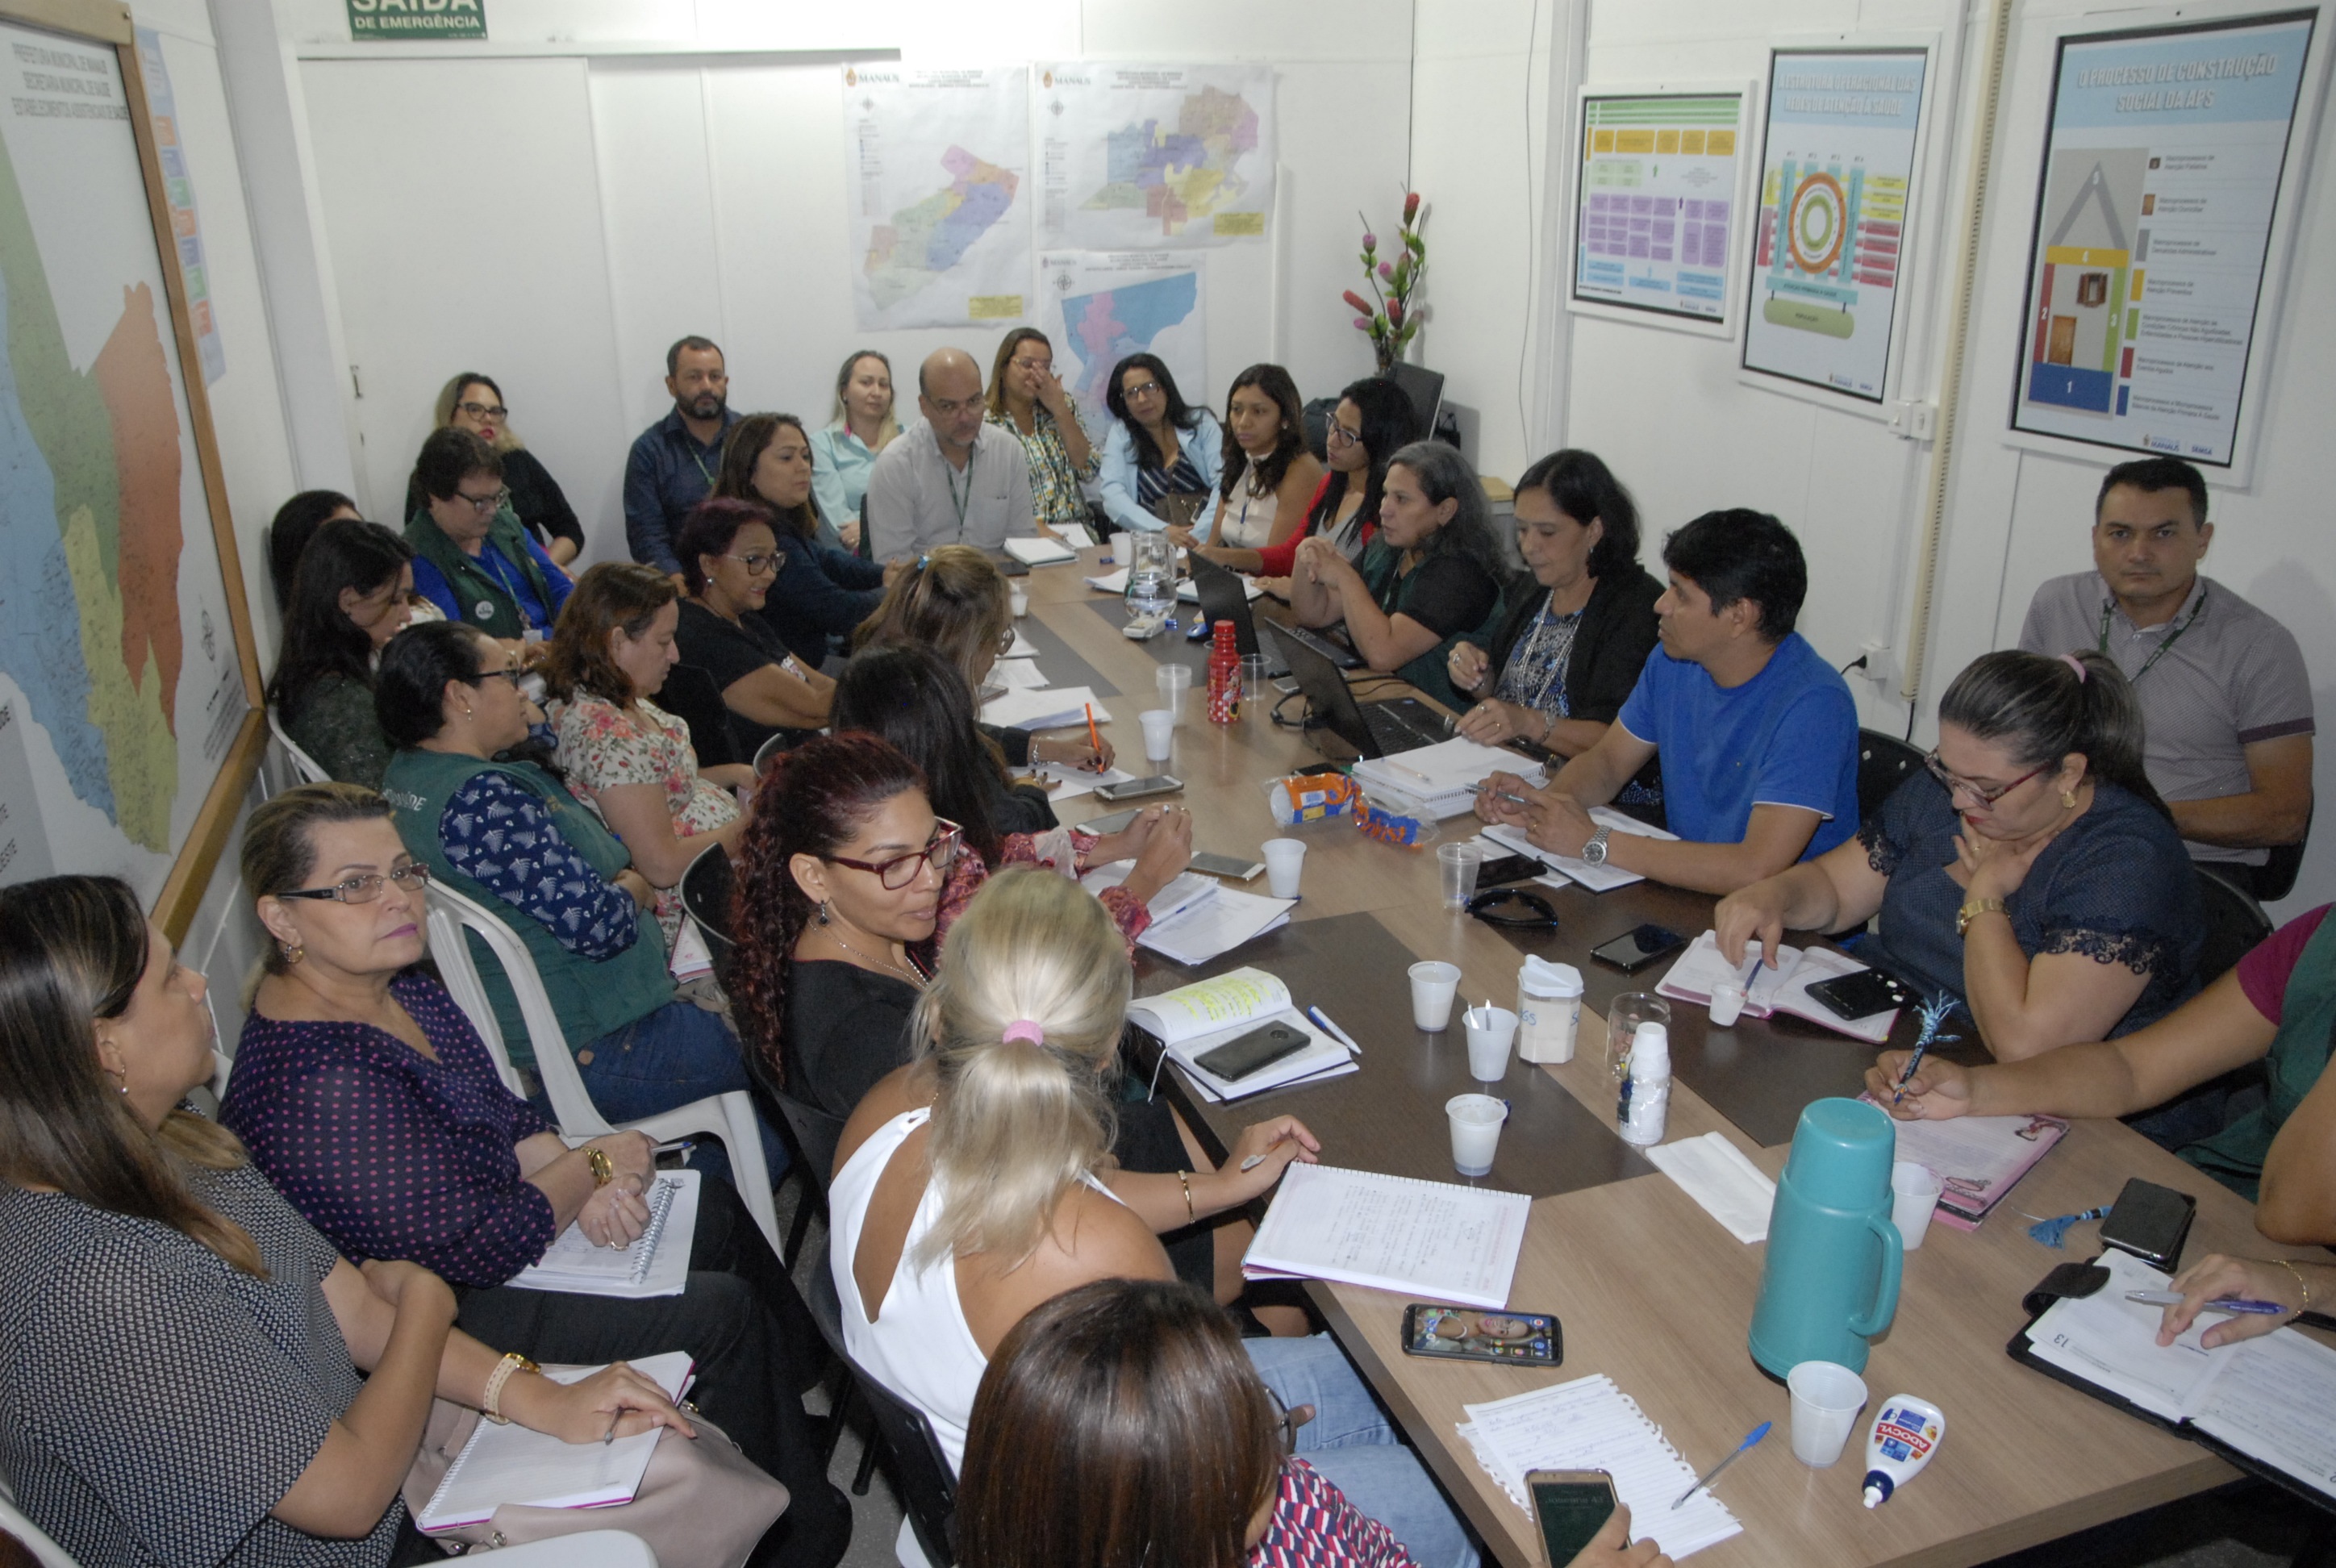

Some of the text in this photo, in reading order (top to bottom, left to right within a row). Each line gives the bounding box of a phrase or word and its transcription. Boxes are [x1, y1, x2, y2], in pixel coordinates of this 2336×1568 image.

[354, 13, 481, 29] DE EMERGÊNCIA
[2078, 52, 2278, 89] O PROCESSO DE CONSTRUÇÃO
[858, 74, 900, 83] MANAUS
[1054, 77, 1091, 85] MANAUS
[2117, 88, 2215, 113] SOCIAL DA APS
[2082, 251, 2088, 262] 4
[2041, 307, 2047, 319] 2
[2110, 314, 2117, 327] 3
[2067, 381, 2072, 393] 1
[2054, 1333, 2069, 1348] 13
[1879, 1424, 1928, 1449] ADOCYL
